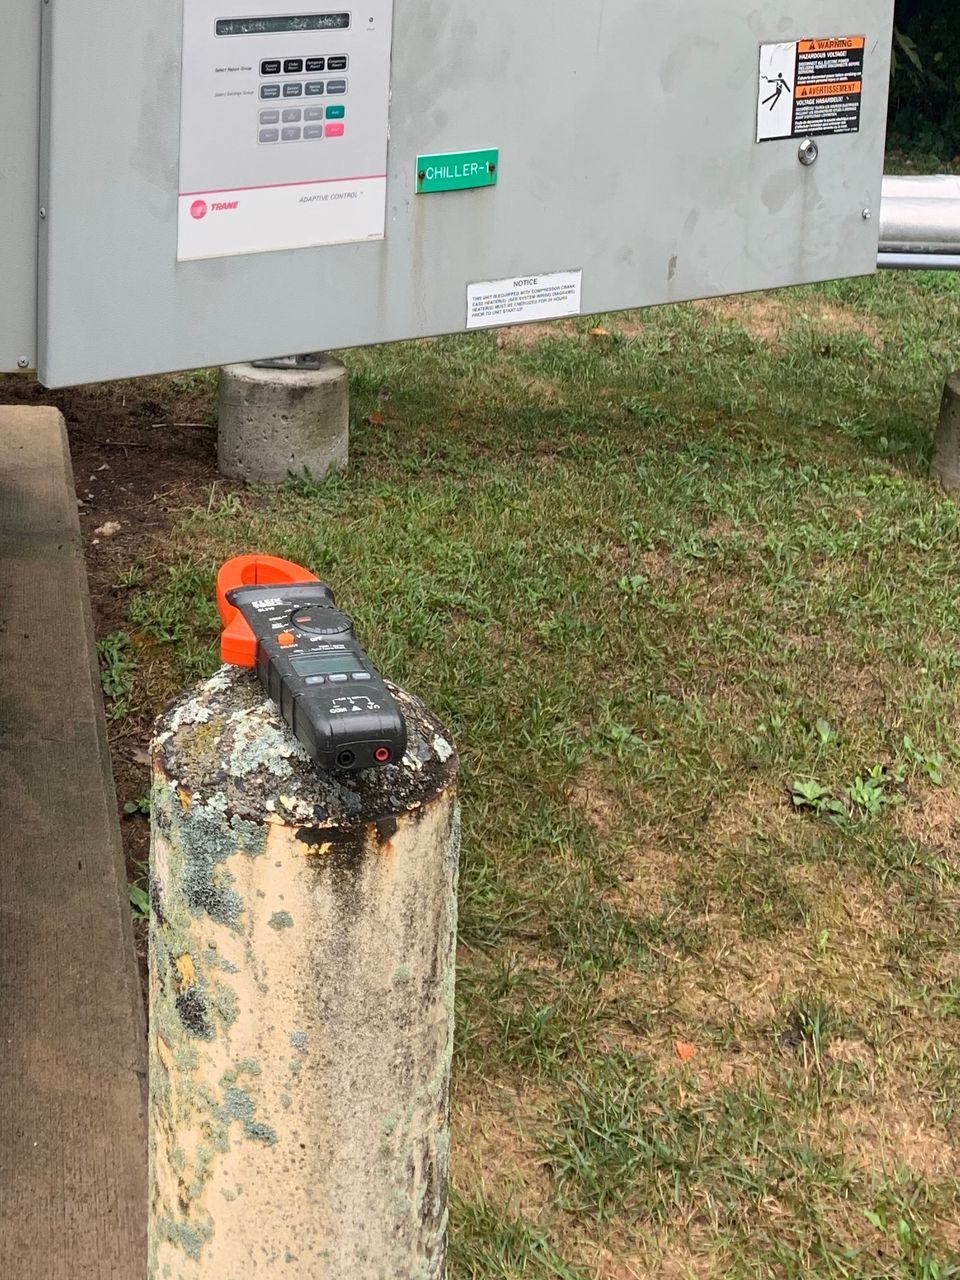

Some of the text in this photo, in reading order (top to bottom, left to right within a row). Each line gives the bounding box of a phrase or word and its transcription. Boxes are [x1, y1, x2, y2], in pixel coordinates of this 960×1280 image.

[818, 40, 852, 49] WARNING
[808, 84, 855, 95] AVERTISSEMENT
[426, 161, 489, 180] CHILLER-1
[299, 195, 329, 203] ADAPTIVE
[211, 201, 240, 211] TRANE
[513, 278, 538, 287] NOTICE
